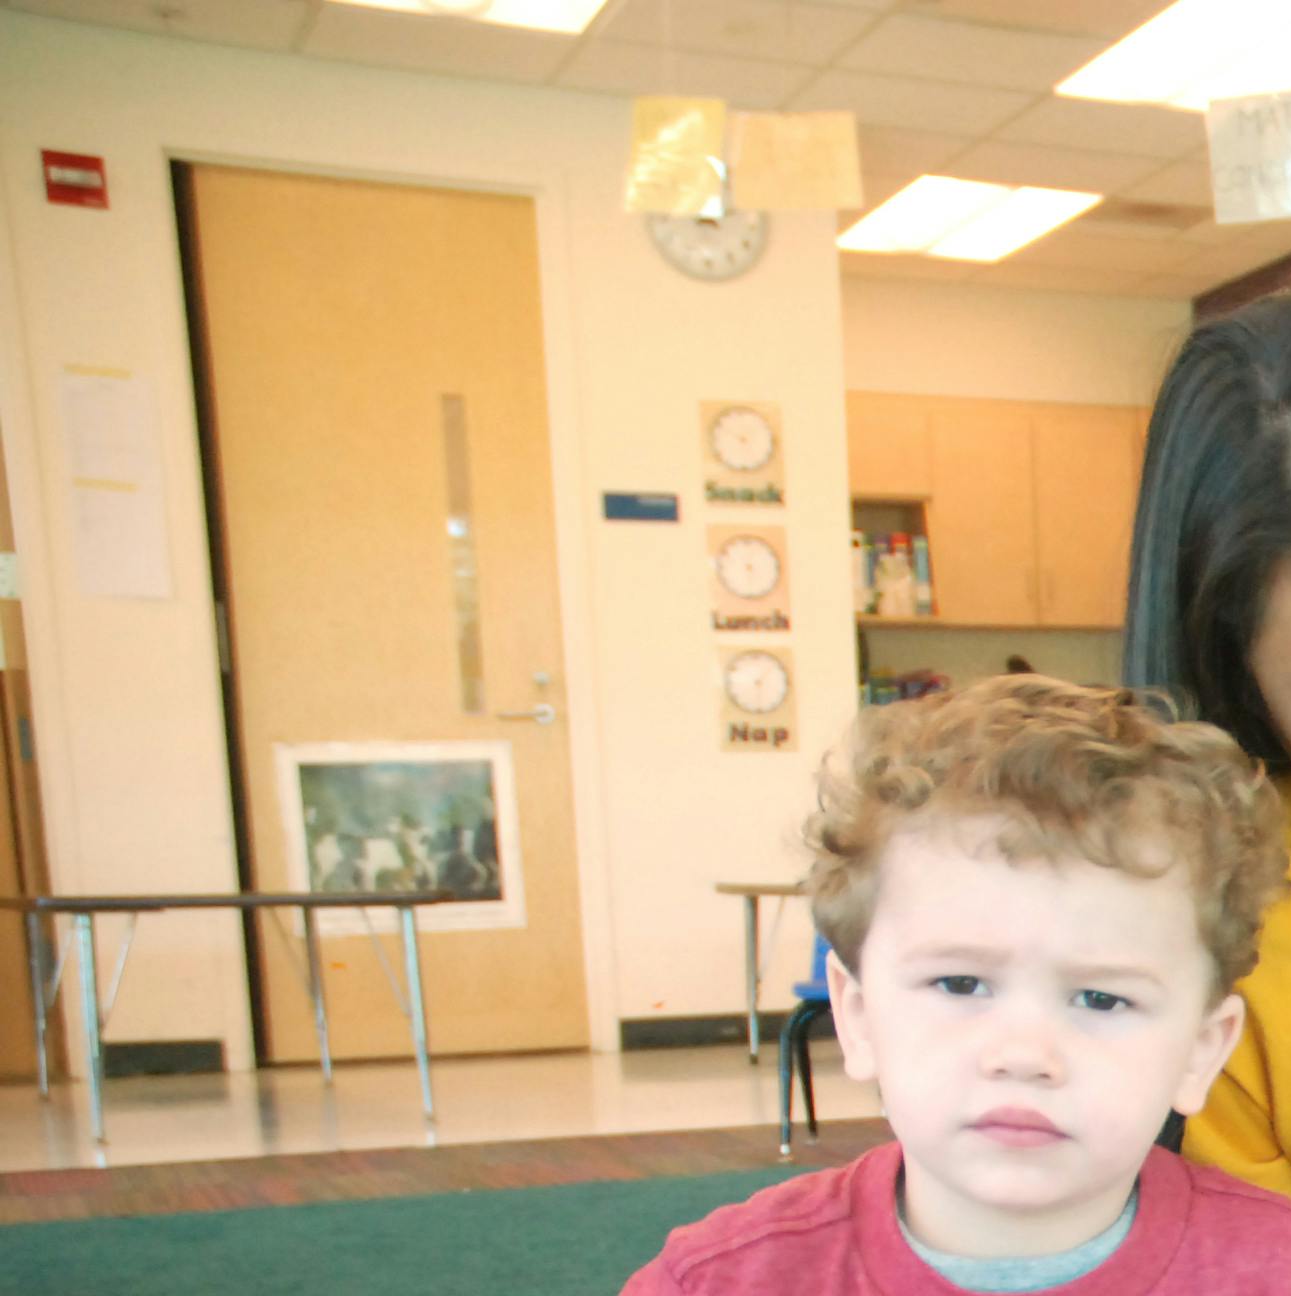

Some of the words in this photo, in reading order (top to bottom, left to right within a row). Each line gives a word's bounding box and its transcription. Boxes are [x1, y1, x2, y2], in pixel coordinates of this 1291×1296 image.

[704, 480, 784, 504] Snack
[711, 609, 790, 631] Lunch
[727, 721, 789, 747] Nap
